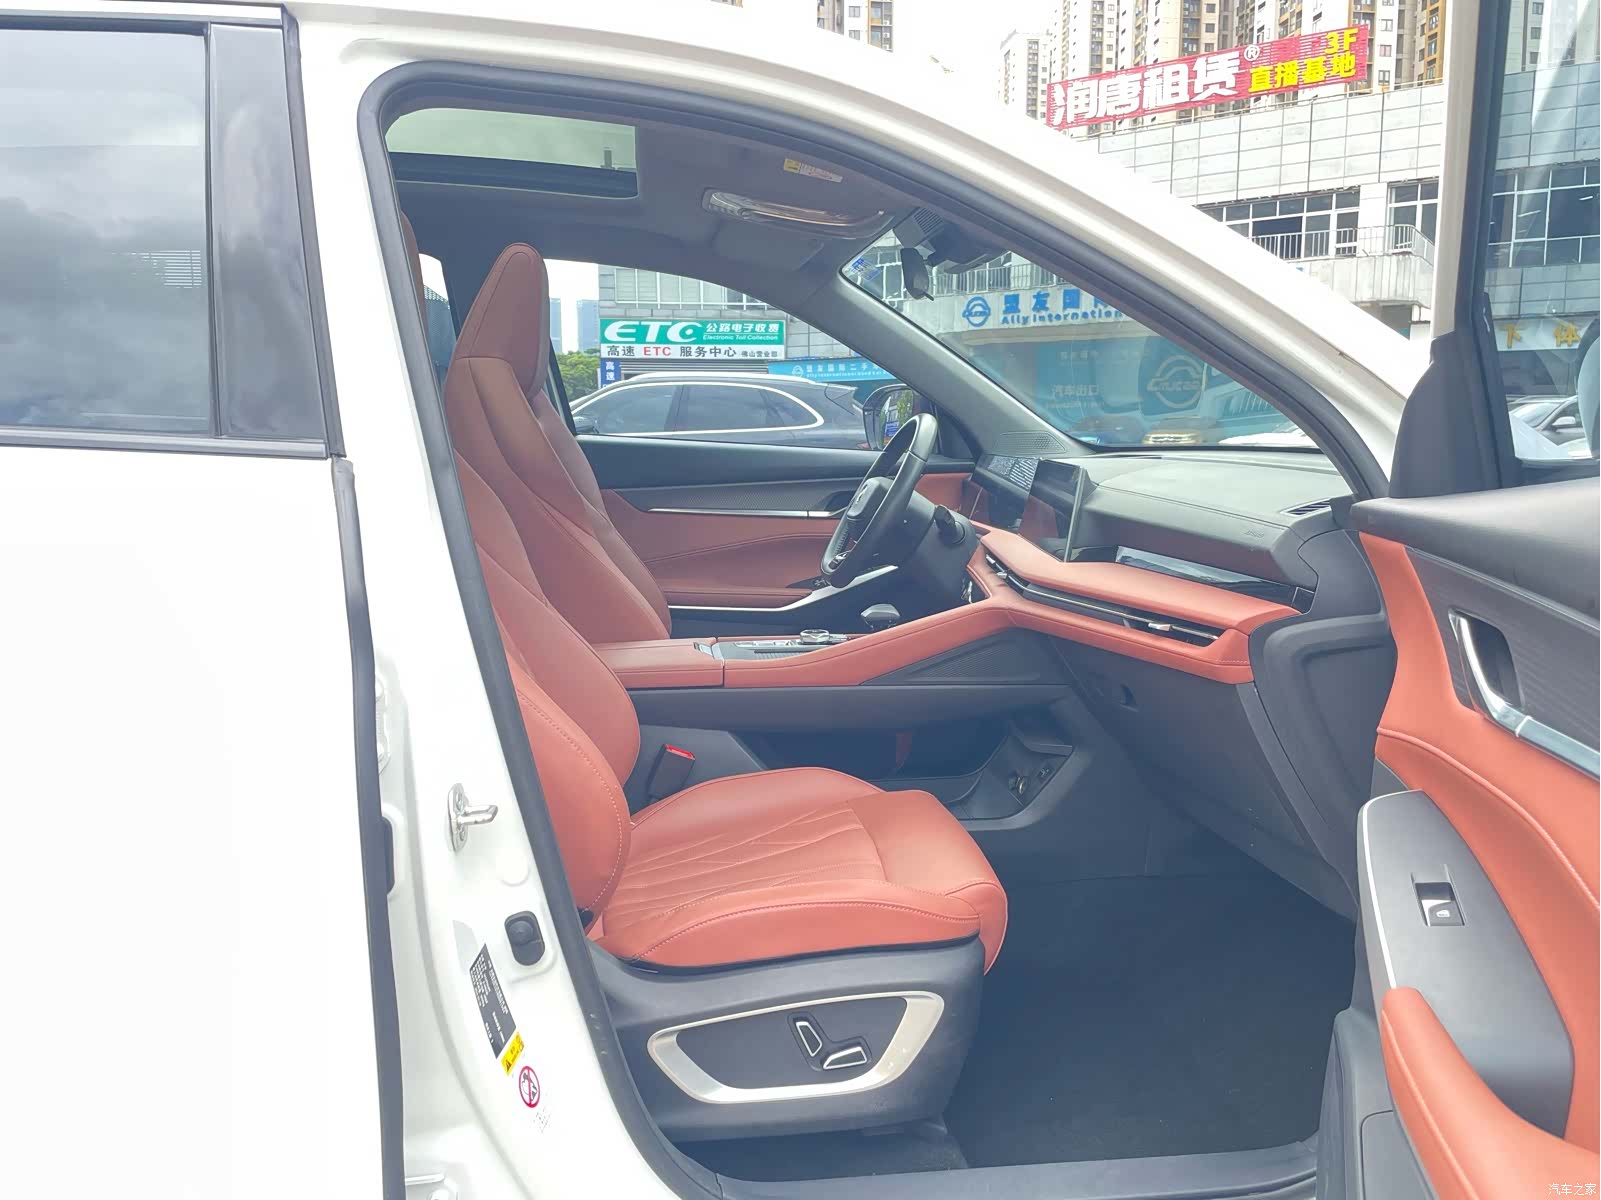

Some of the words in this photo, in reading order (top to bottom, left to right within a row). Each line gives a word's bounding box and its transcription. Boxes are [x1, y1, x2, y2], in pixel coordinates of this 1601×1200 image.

[1325, 28, 1358, 54] 3F
[1248, 54, 1356, 93] 直播基地
[1051, 51, 1241, 126] 润唐租赁
[706, 323, 779, 333] 公路电子收费
[1001, 314, 1029, 325] Ally
[604, 320, 702, 343] ETC
[607, 345, 635, 357] 高速
[643, 346, 671, 356] ETC
[680, 345, 737, 357] 服务中心
[605, 361, 615, 381] 高速
